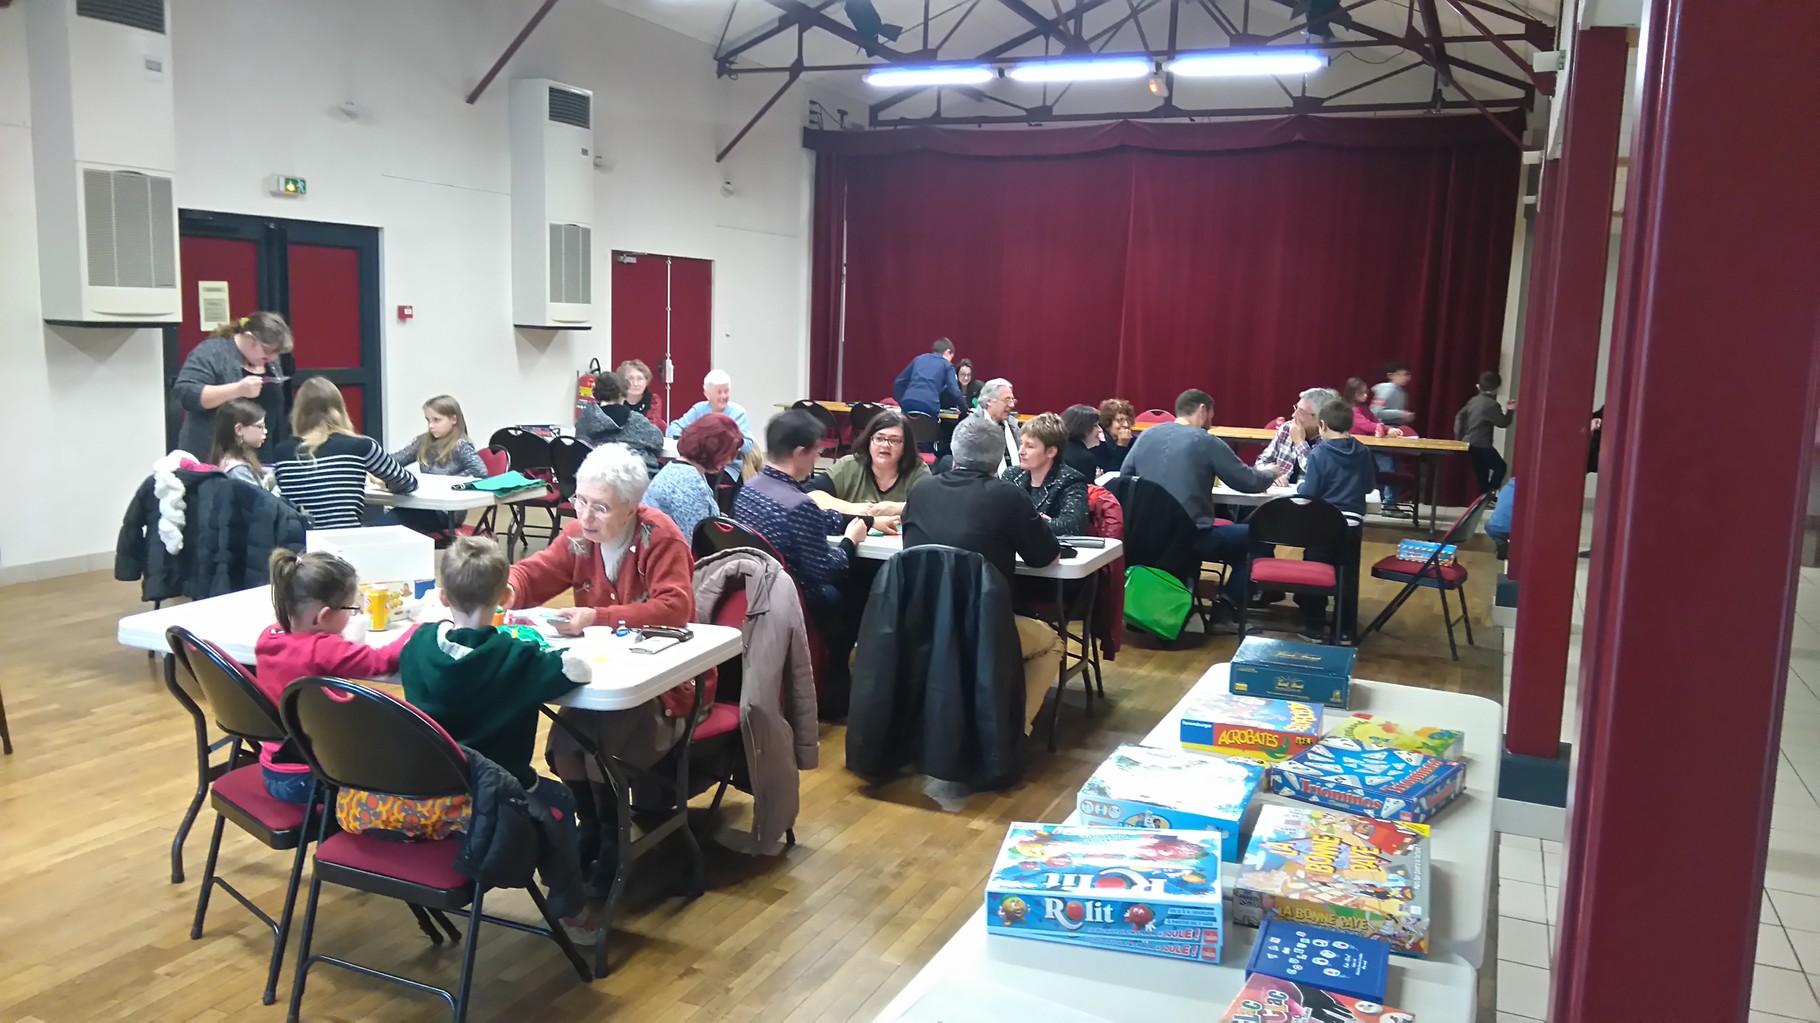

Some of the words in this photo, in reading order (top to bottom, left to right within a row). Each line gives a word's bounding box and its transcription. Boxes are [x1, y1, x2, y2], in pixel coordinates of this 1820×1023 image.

[1218, 729, 1279, 748] ACROBATES
[1301, 779, 1383, 811] Triominos
[1270, 841, 1298, 856] LA
[1305, 834, 1342, 873] BONNE
[1349, 845, 1382, 872] PAYE
[1044, 897, 1114, 931] Rolit
[1279, 906, 1294, 917] LA
[1296, 908, 1337, 926] BONNE
[1340, 915, 1369, 931] PAYE
[1260, 990, 1288, 1023] Clac
